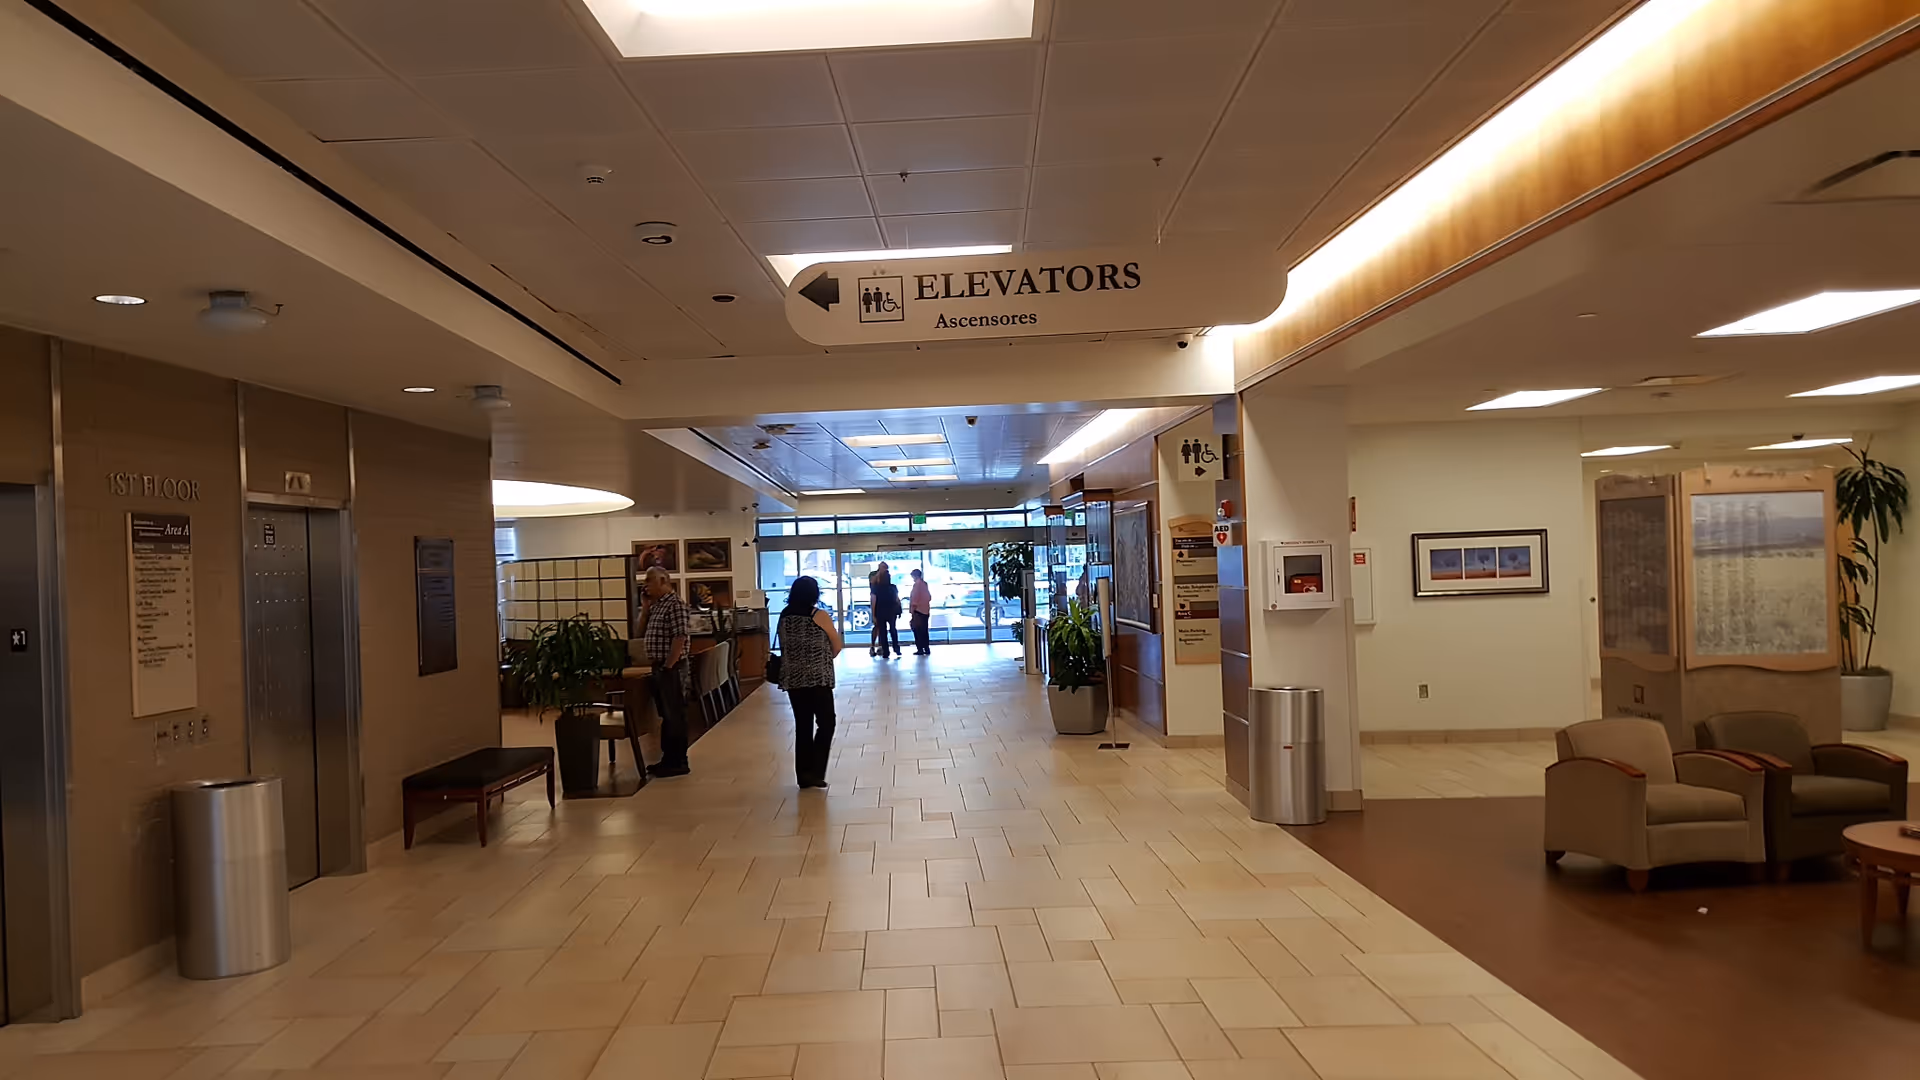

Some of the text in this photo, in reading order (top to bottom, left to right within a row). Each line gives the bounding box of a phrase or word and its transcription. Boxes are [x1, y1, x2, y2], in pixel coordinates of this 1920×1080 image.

[913, 262, 1141, 300] ELEVATORS
[934, 312, 1038, 329] Ascensores
[105, 471, 201, 502] 1ST FLOOR
[164, 523, 190, 536] Area A
